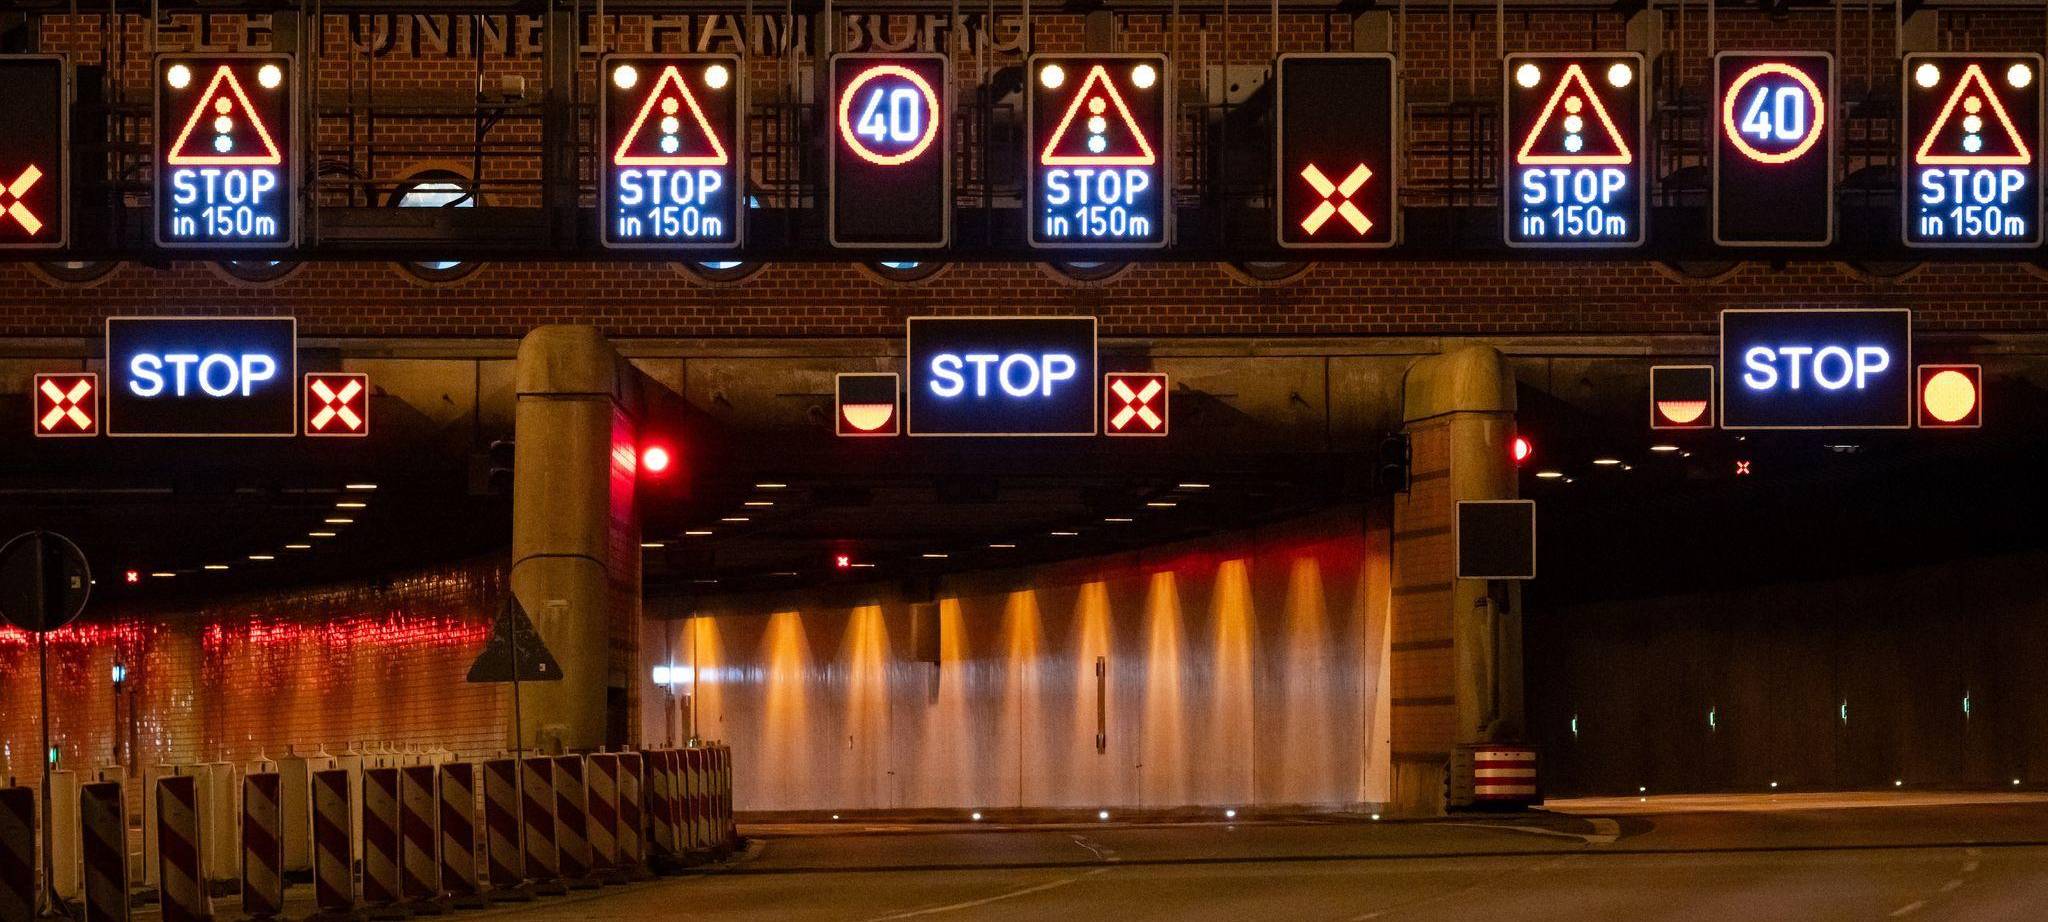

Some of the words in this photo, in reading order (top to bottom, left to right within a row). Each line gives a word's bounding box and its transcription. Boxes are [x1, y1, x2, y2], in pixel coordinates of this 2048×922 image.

[856, 87, 920, 143] 40
[1741, 86, 1806, 141] 40
[173, 169, 277, 205] STOP
[619, 169, 723, 205] STOP
[1046, 169, 1150, 205] STOP
[1522, 169, 1626, 205] STOP
[1921, 169, 2025, 205] STOP
[173, 207, 195, 237] in
[201, 206, 277, 237] 150m
[619, 207, 641, 237] in
[647, 206, 723, 237] 150m
[1046, 207, 1068, 237] in
[1074, 206, 1150, 237] 150m
[1522, 207, 1544, 237] in
[1550, 206, 1626, 237] 150m
[1921, 207, 1943, 237] in
[1949, 206, 2025, 237] 150m
[128, 352, 277, 398] STOP
[928, 352, 1078, 398] STOP
[1743, 345, 1891, 391] STOP
